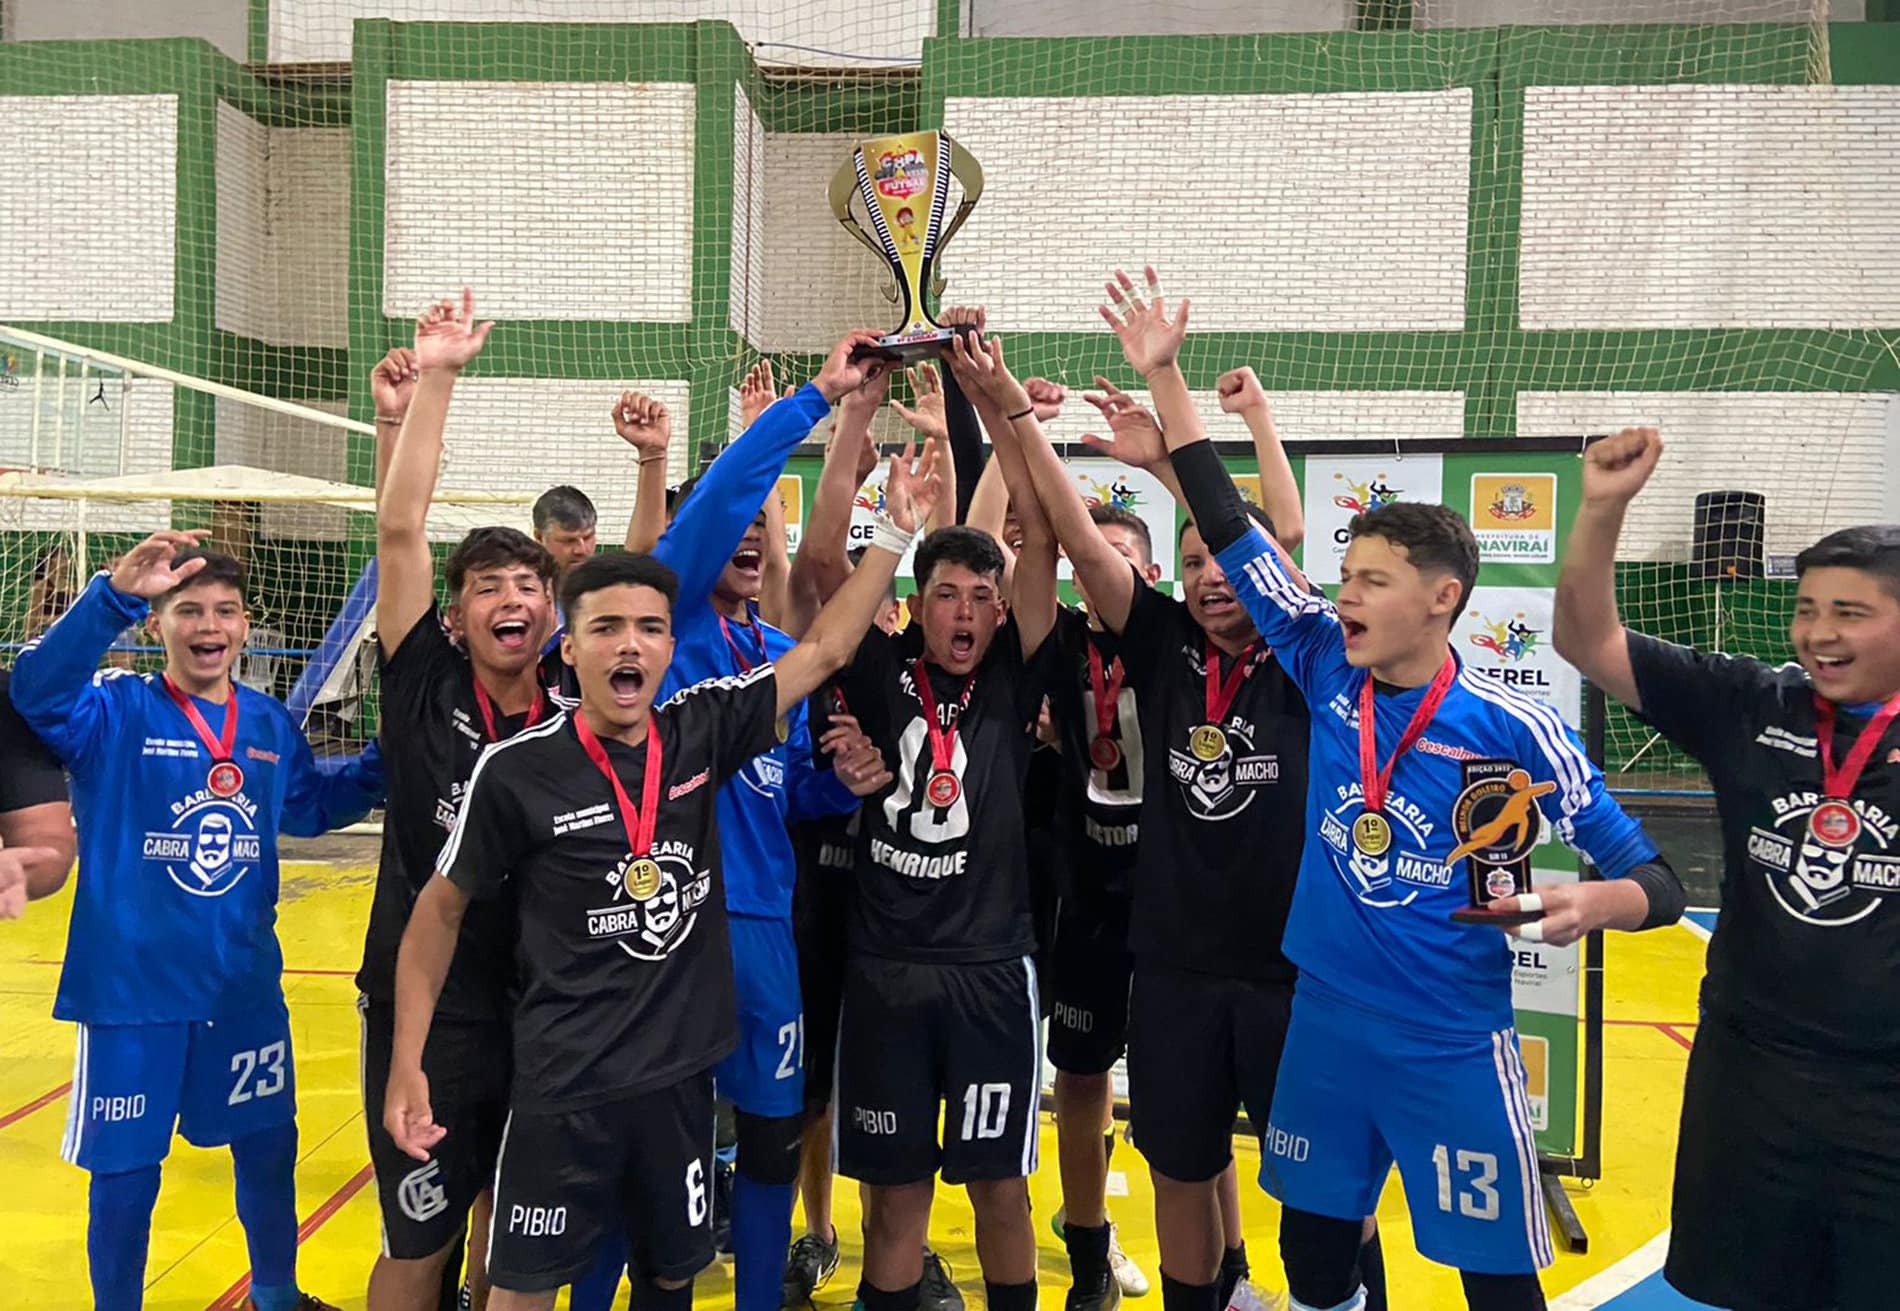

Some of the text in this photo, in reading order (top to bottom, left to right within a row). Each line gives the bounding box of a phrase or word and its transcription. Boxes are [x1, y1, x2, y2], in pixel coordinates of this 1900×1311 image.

[1236, 762, 1279, 781] MACHO
[143, 838, 190, 858] CABRA
[870, 838, 968, 879] HENRIQUE
[1748, 833, 1792, 867] CABRA
[1396, 857, 1452, 886] MACHO
[587, 911, 638, 936] CABRA
[1054, 1001, 1093, 1033] PIBID
[228, 1040, 286, 1106] 23
[92, 1094, 146, 1122] PIBID
[855, 1106, 897, 1135] PIBID
[961, 1082, 1012, 1141] 10
[686, 1157, 707, 1227] 6
[1432, 1144, 1500, 1221] 13
[509, 1203, 567, 1236] PIBID
